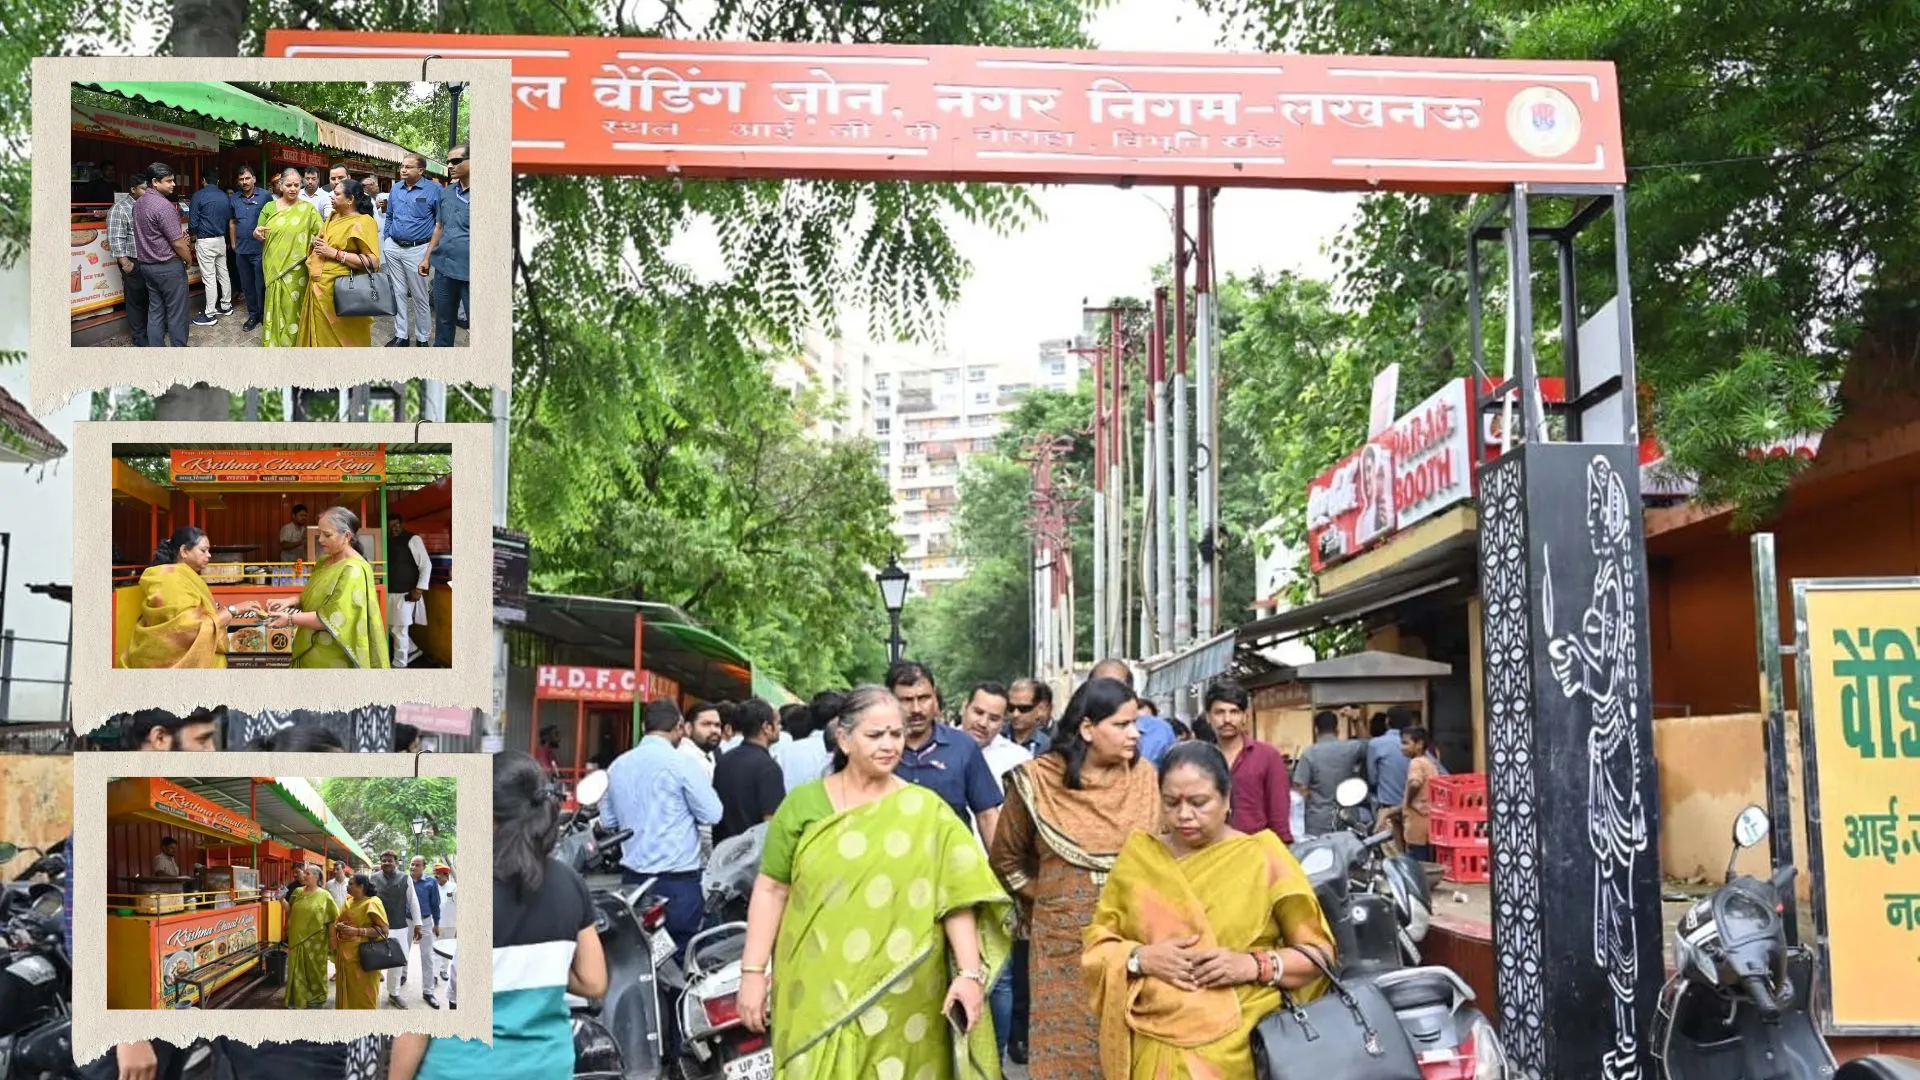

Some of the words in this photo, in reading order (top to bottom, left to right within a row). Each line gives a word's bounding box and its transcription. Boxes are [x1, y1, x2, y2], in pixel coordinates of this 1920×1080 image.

[591, 64, 747, 113] वेंडिंग
[933, 83, 1062, 121] नगर
[181, 458, 261, 473] Krishna
[324, 458, 375, 474] King
[1394, 448, 1457, 512] BOOTH
[166, 926, 213, 947] Krishna
